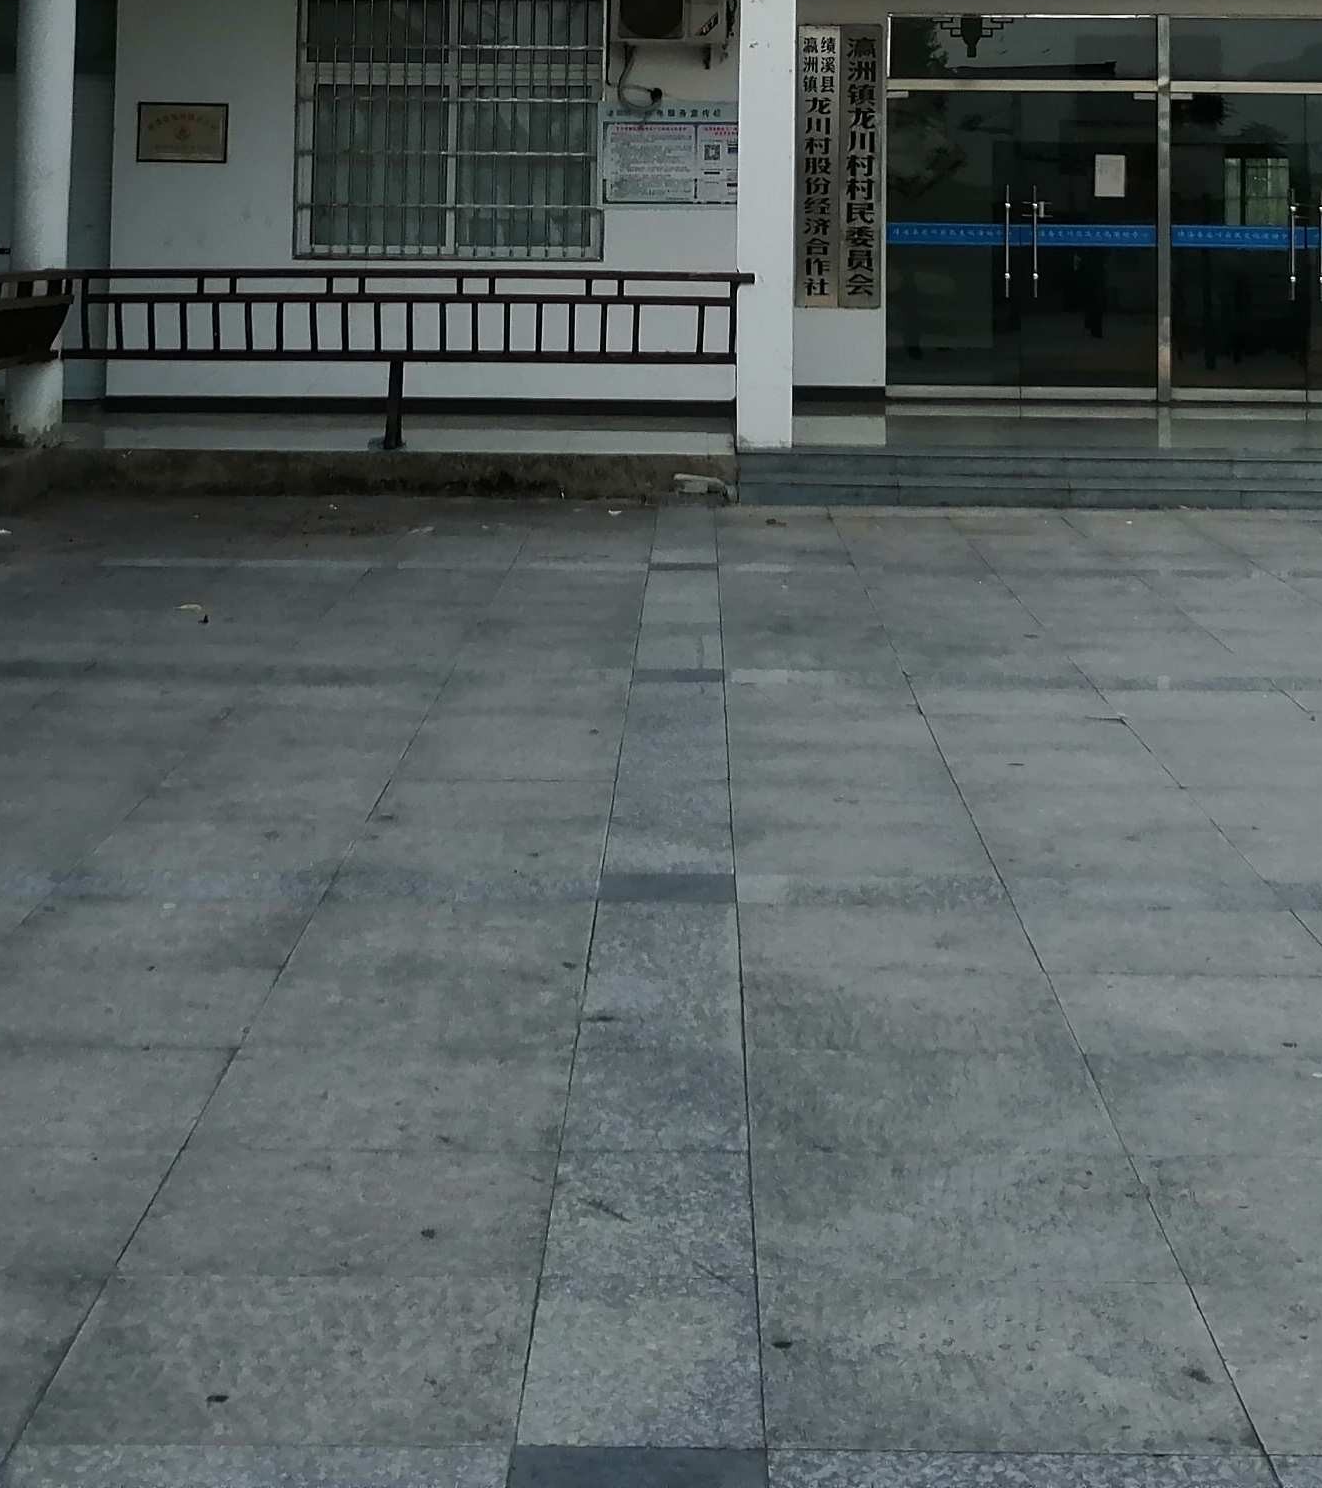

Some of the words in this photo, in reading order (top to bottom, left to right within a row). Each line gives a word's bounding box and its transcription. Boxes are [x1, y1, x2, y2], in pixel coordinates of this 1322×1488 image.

[804, 97, 830, 297] 龙川村股份经济合作社
[845, 38, 876, 297] 瀛洲镇龙川村村民委员会
